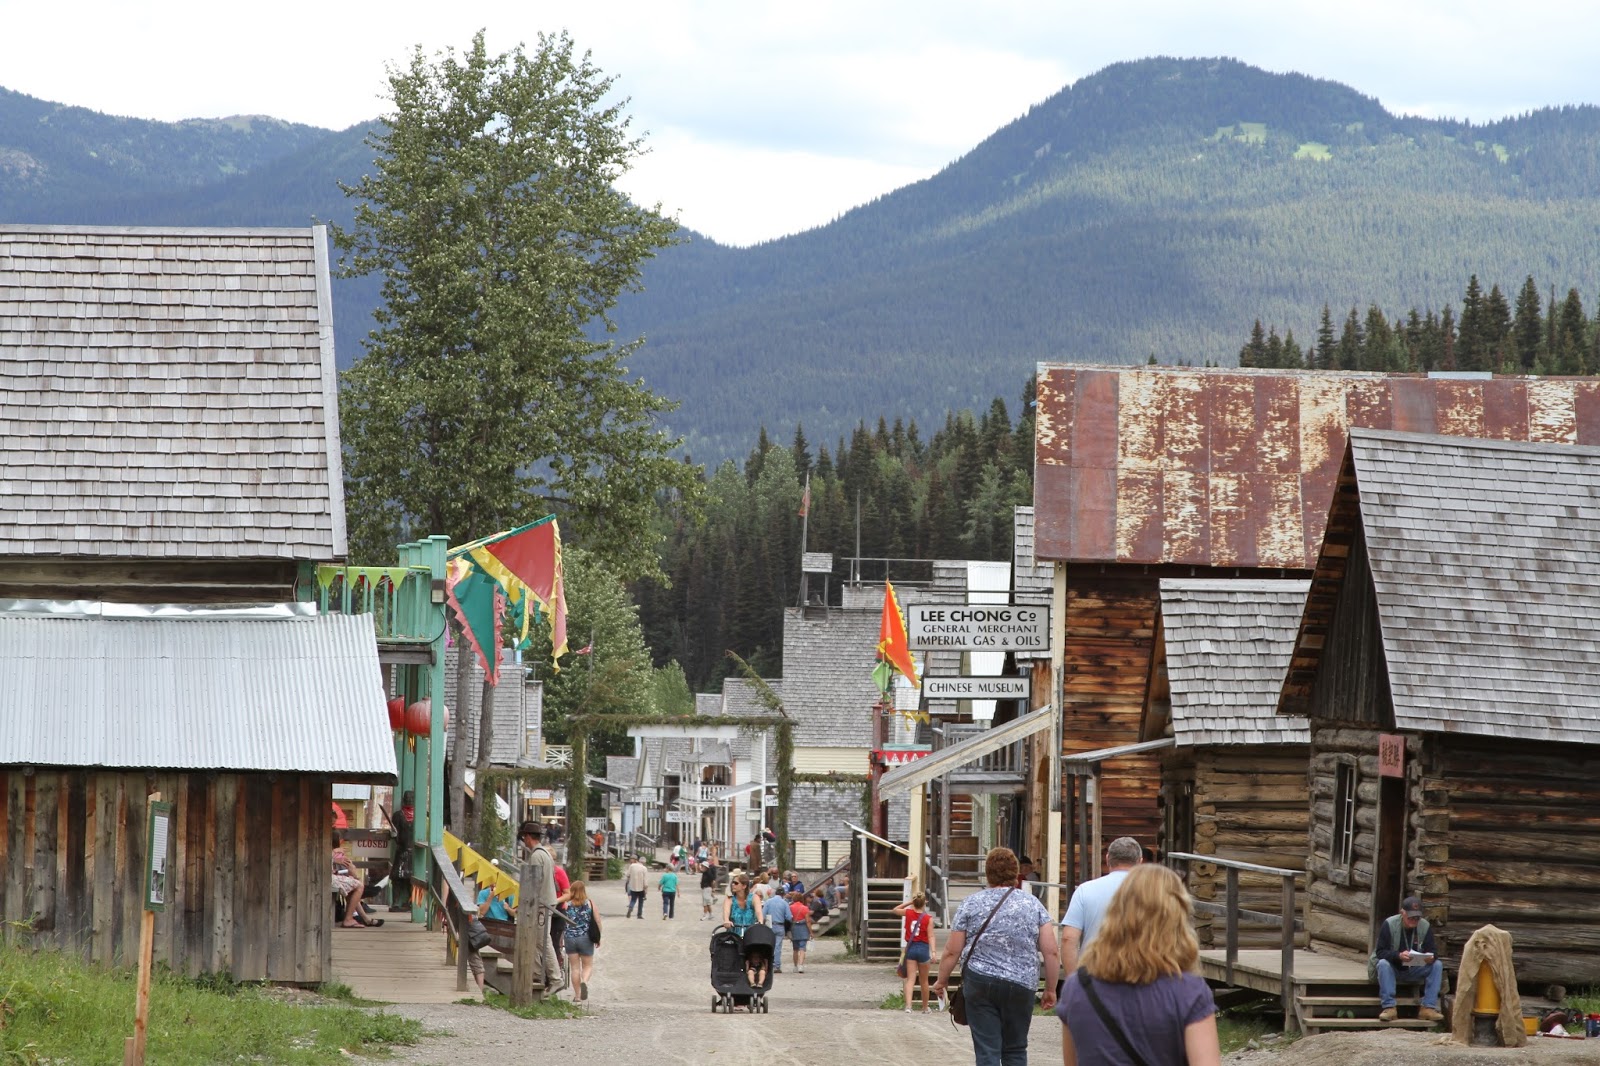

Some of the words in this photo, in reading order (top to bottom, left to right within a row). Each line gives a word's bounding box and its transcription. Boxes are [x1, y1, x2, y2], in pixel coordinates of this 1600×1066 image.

[921, 610, 945, 622] LEE
[950, 610, 1012, 622] CHONG
[923, 625, 971, 633] GENERAL
[977, 624, 1038, 633] MERCHANT
[917, 636, 968, 646] IMPERIAL
[973, 636, 996, 646] GAS
[1001, 637, 1009, 646] &
[1015, 636, 1041, 646] OILS
[929, 682, 973, 693] CHINESE
[978, 682, 1024, 693] MUSEUM
[357, 839, 388, 849] CLOSED
